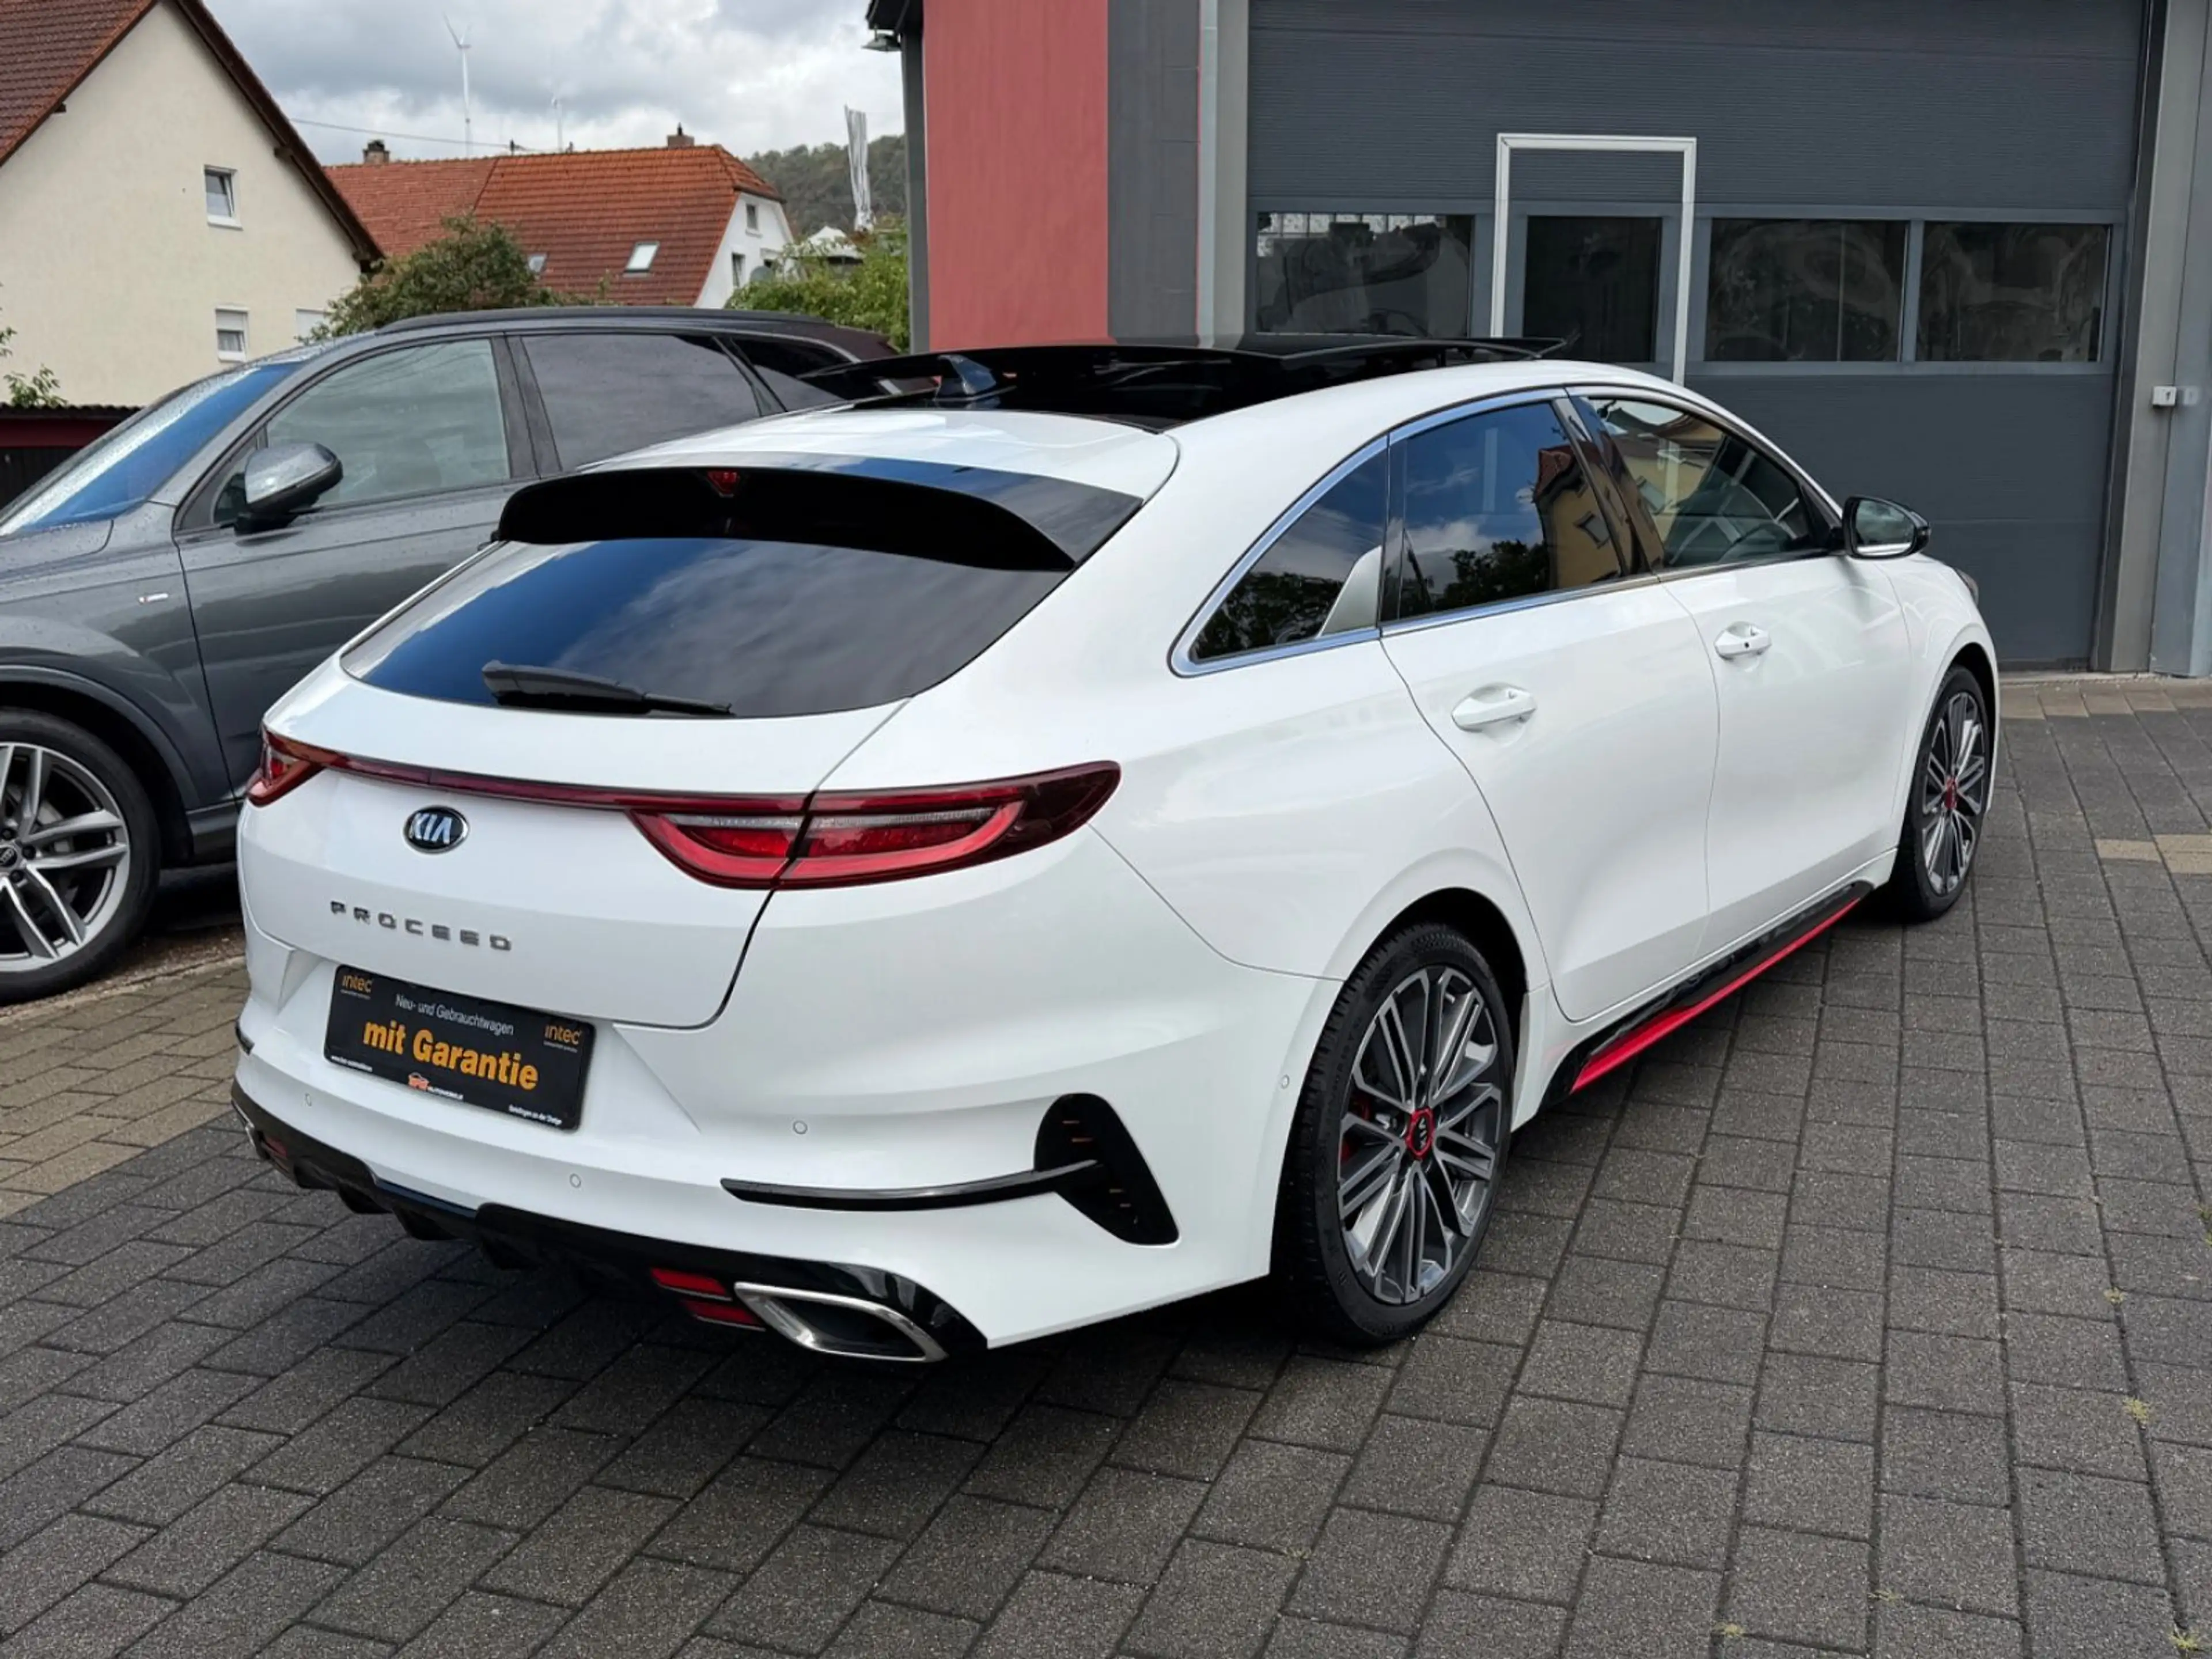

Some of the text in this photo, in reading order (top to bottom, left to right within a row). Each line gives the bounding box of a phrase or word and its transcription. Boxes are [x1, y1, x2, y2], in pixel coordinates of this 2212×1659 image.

[409, 813, 452, 844] KIA
[330, 900, 512, 951] PROCEED
[342, 975, 373, 993] intec
[395, 993, 514, 1036] Neu- und Gebrauchtwagen
[544, 1024, 582, 1045] intec
[363, 1020, 539, 1090] mit Garantie
